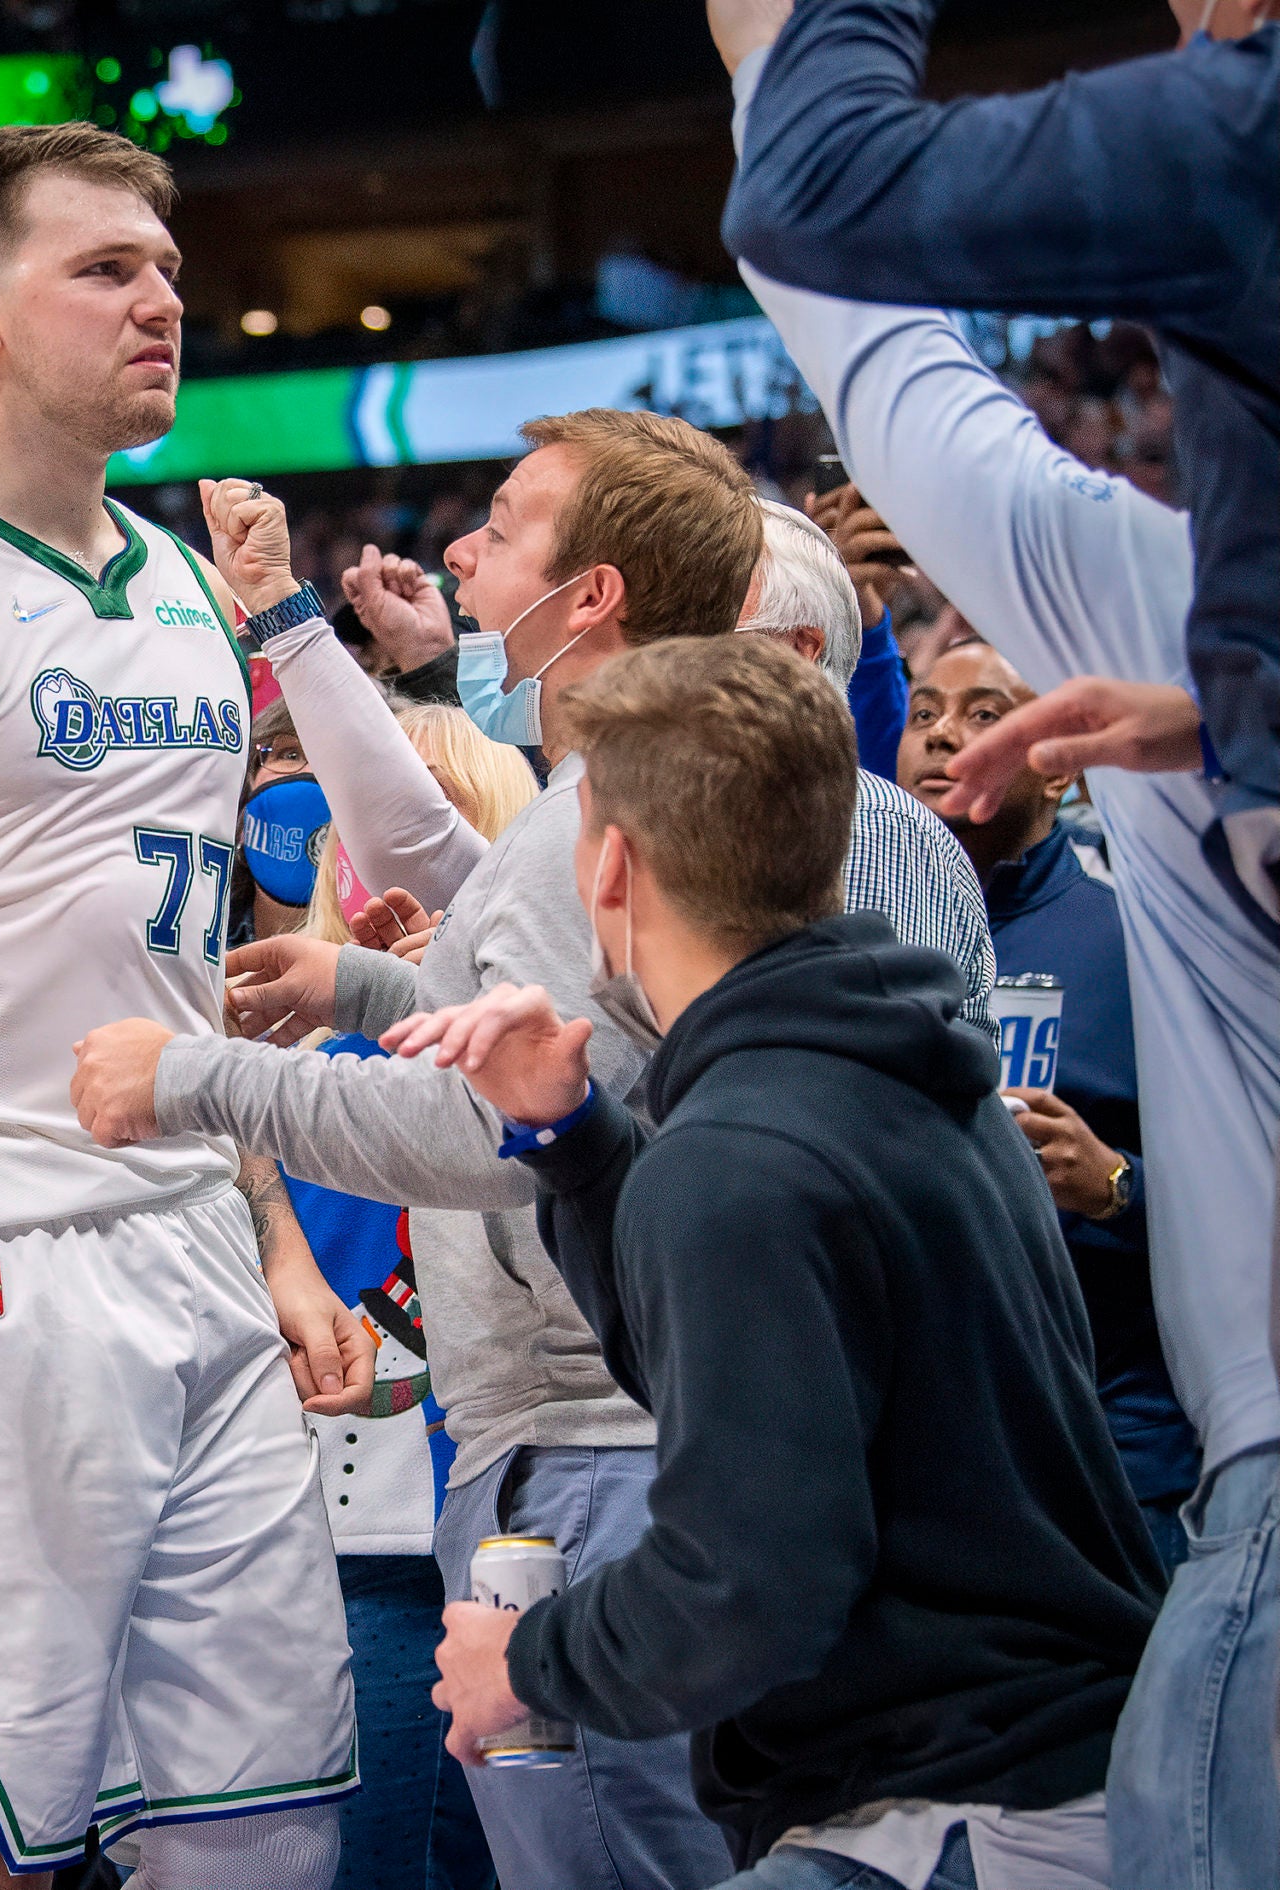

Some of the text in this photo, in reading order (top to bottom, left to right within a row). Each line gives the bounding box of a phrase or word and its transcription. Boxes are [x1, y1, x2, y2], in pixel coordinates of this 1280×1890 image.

[155, 599, 217, 630] chime
[42, 696, 242, 753] DALLAS
[133, 826, 234, 966] 77
